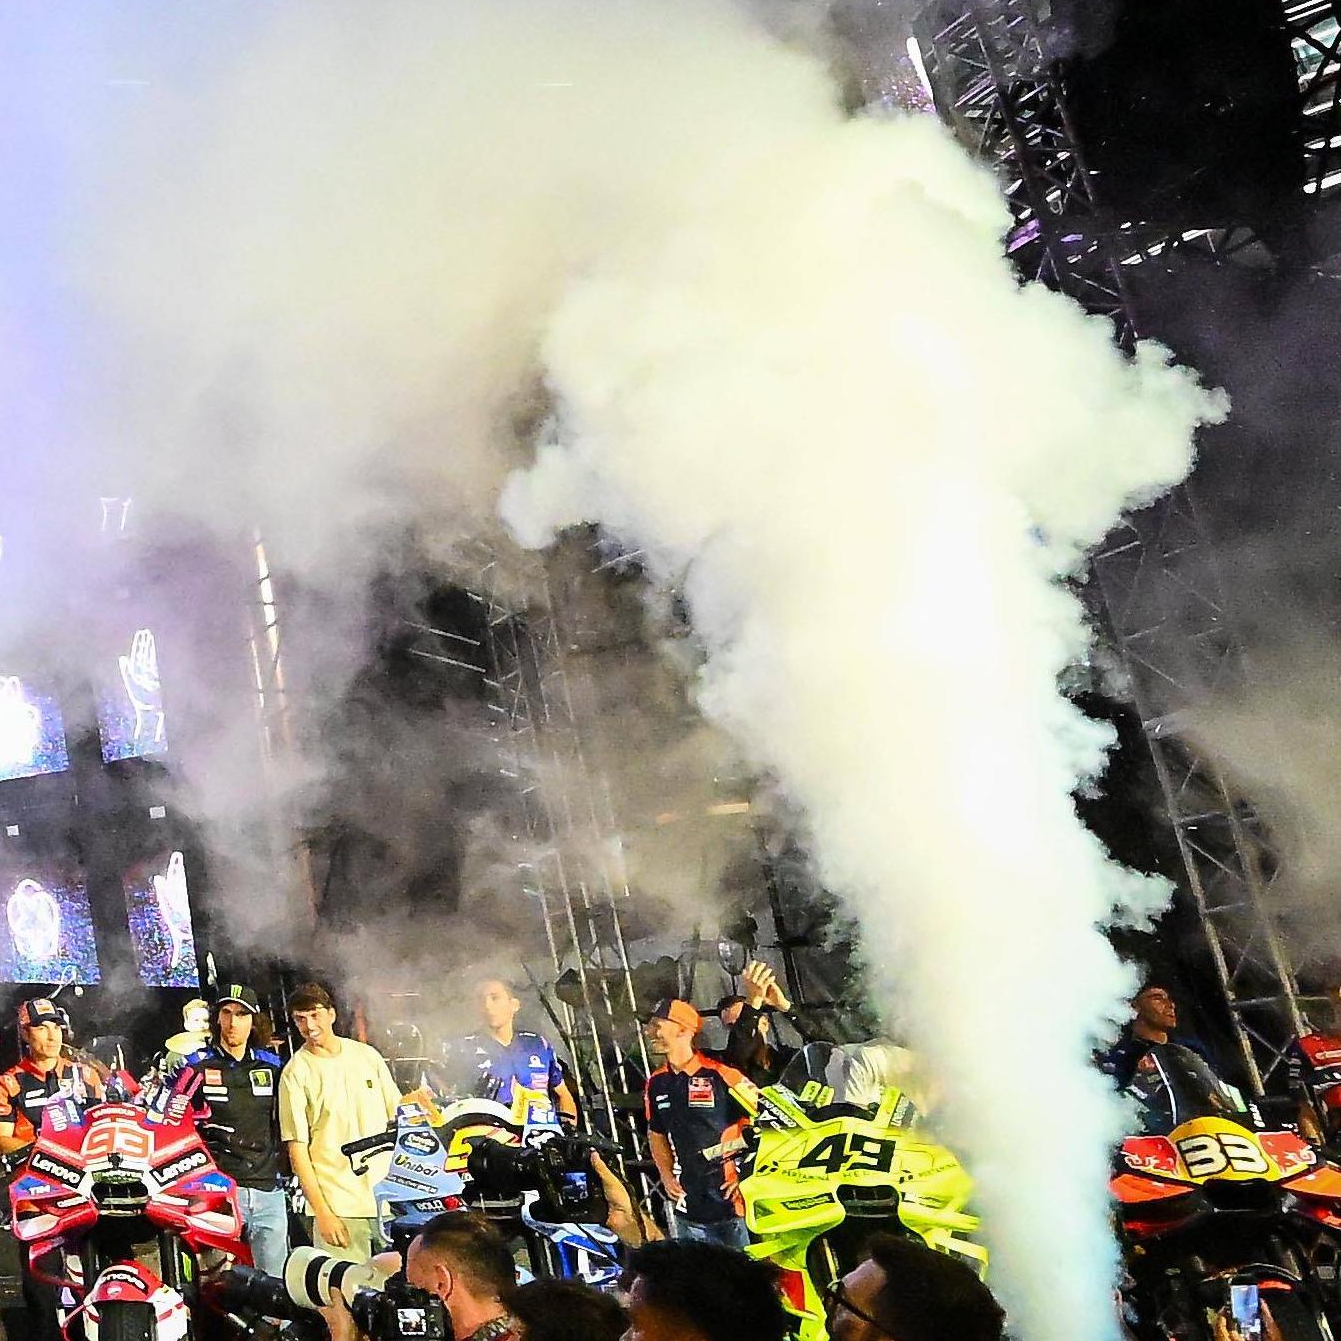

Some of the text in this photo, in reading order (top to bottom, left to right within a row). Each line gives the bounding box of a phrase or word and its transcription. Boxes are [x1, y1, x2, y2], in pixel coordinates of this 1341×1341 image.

[31, 1154, 82, 1184] Lenovo
[152, 1152, 207, 1182] Lenovo
[797, 1133, 896, 1174] 49
[1176, 1133, 1270, 1178] 33
